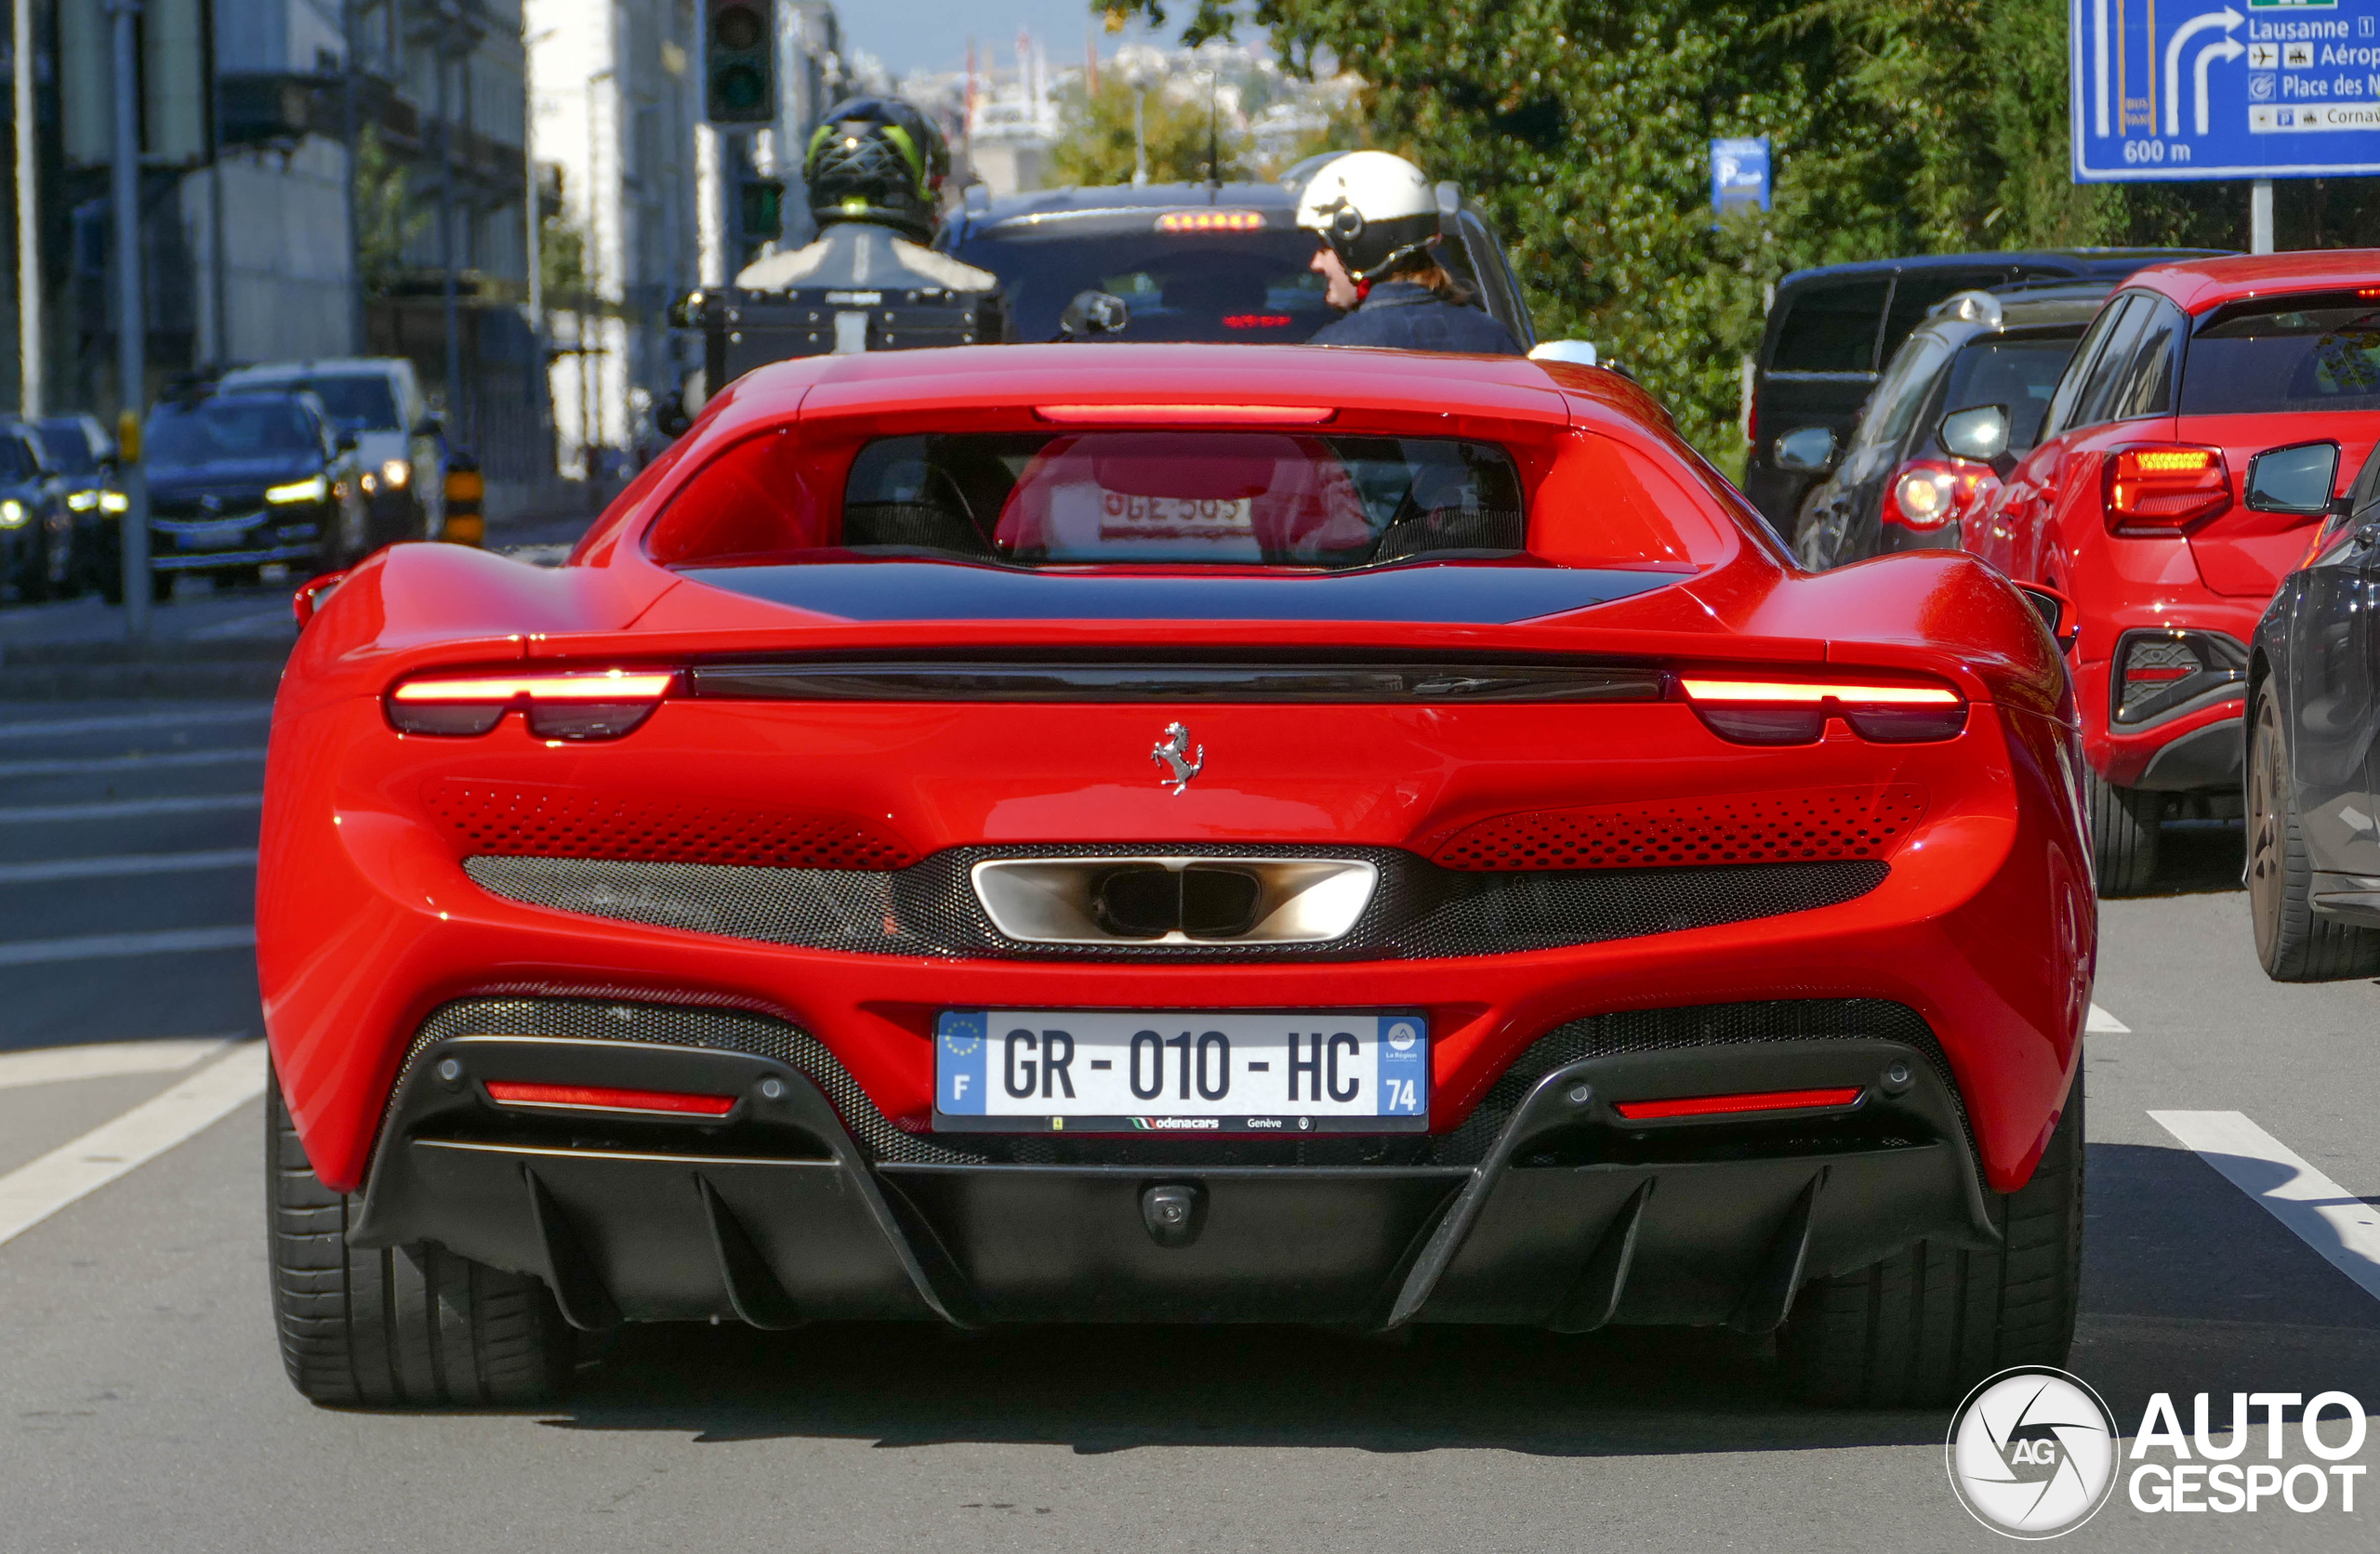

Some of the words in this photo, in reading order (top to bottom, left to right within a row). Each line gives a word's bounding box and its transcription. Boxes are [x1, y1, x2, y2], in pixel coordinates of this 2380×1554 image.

[2250, 18, 2349, 40] Lausanne
[2320, 43, 2380, 70] Aérop
[2283, 74, 2328, 98] Place
[2334, 72, 2362, 96] des
[2126, 98, 2149, 111] BUS
[2125, 112, 2151, 125] TAXI
[2123, 139, 2165, 164] 600
[2171, 144, 2191, 162] m
[1395, 1051, 1418, 1061] Région
[953, 1074, 971, 1100] F
[1385, 1079, 1417, 1112] 74
[1247, 1117, 1282, 1128] Genève
